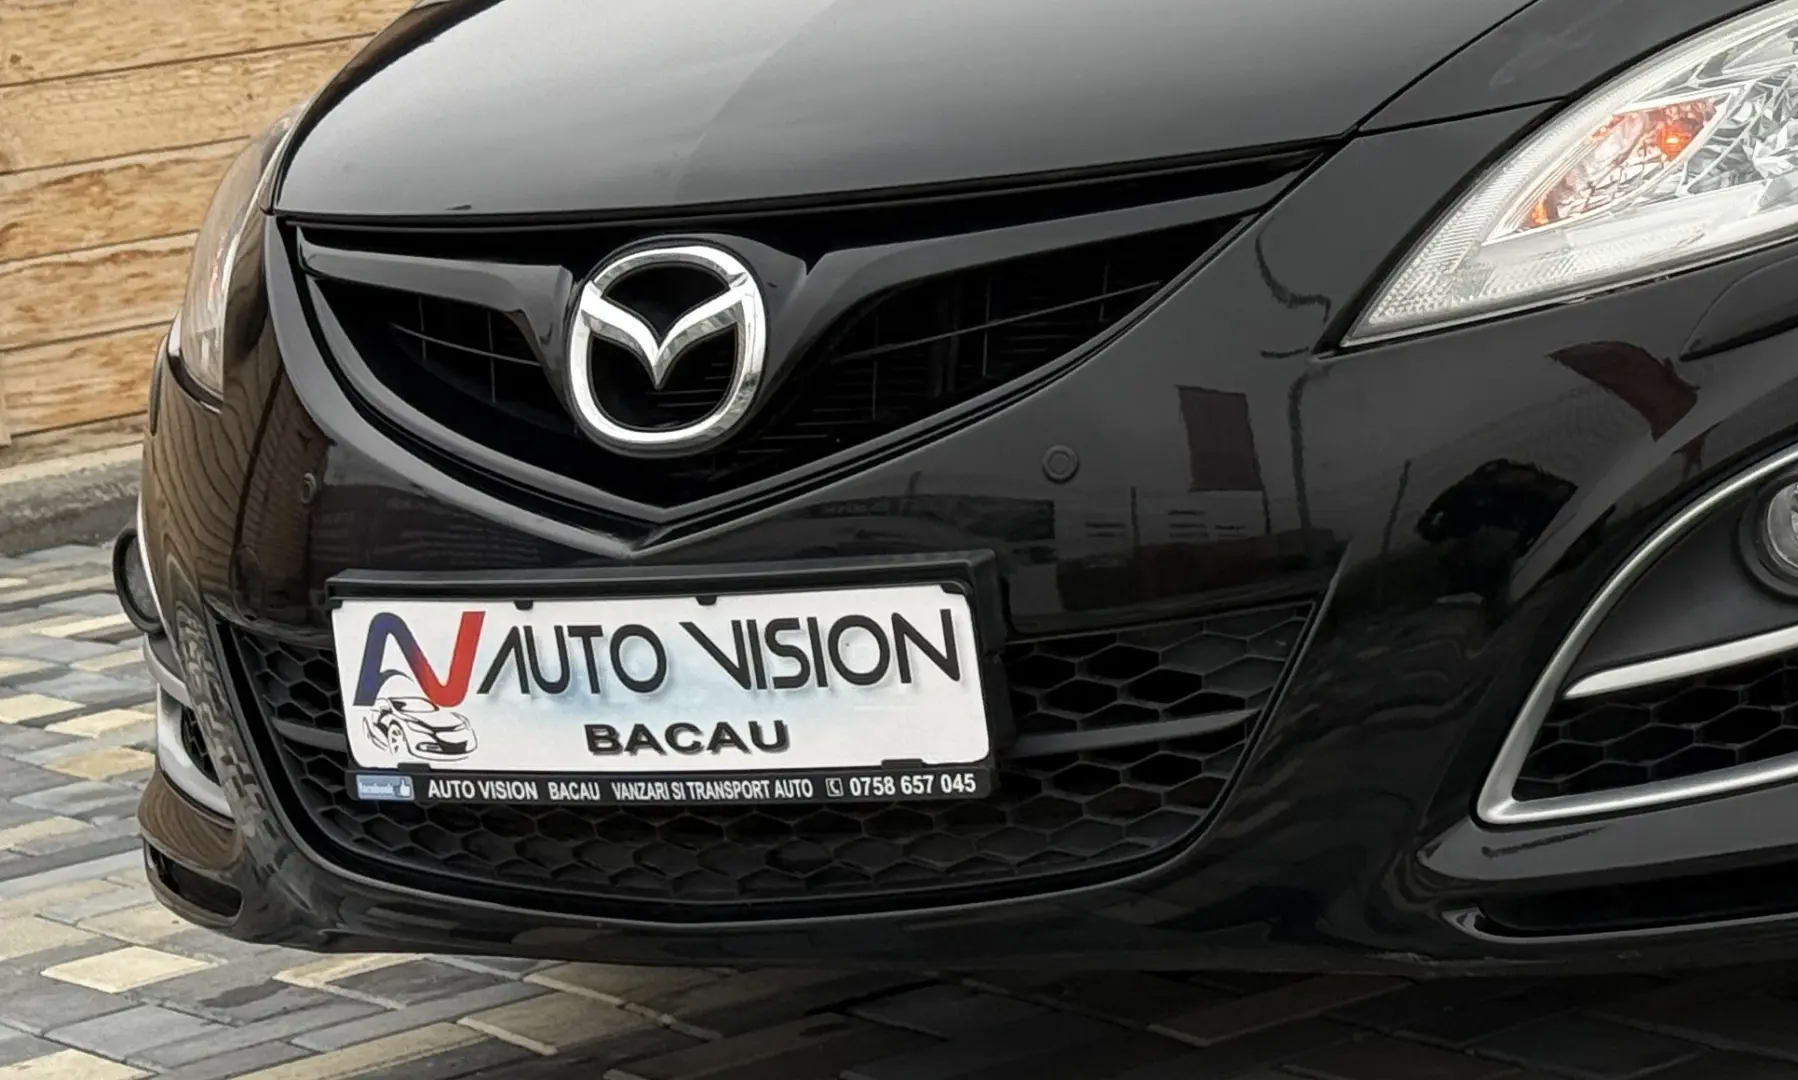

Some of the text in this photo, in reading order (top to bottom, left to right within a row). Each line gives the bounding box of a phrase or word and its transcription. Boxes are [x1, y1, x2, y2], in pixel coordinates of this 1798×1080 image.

[476, 608, 961, 695] AUTO VISION
[585, 719, 790, 757] BACAU
[428, 773, 977, 801] AUTO VISION BACAU VANZARI SI TRANSPORT AUTO 0758 657 045
